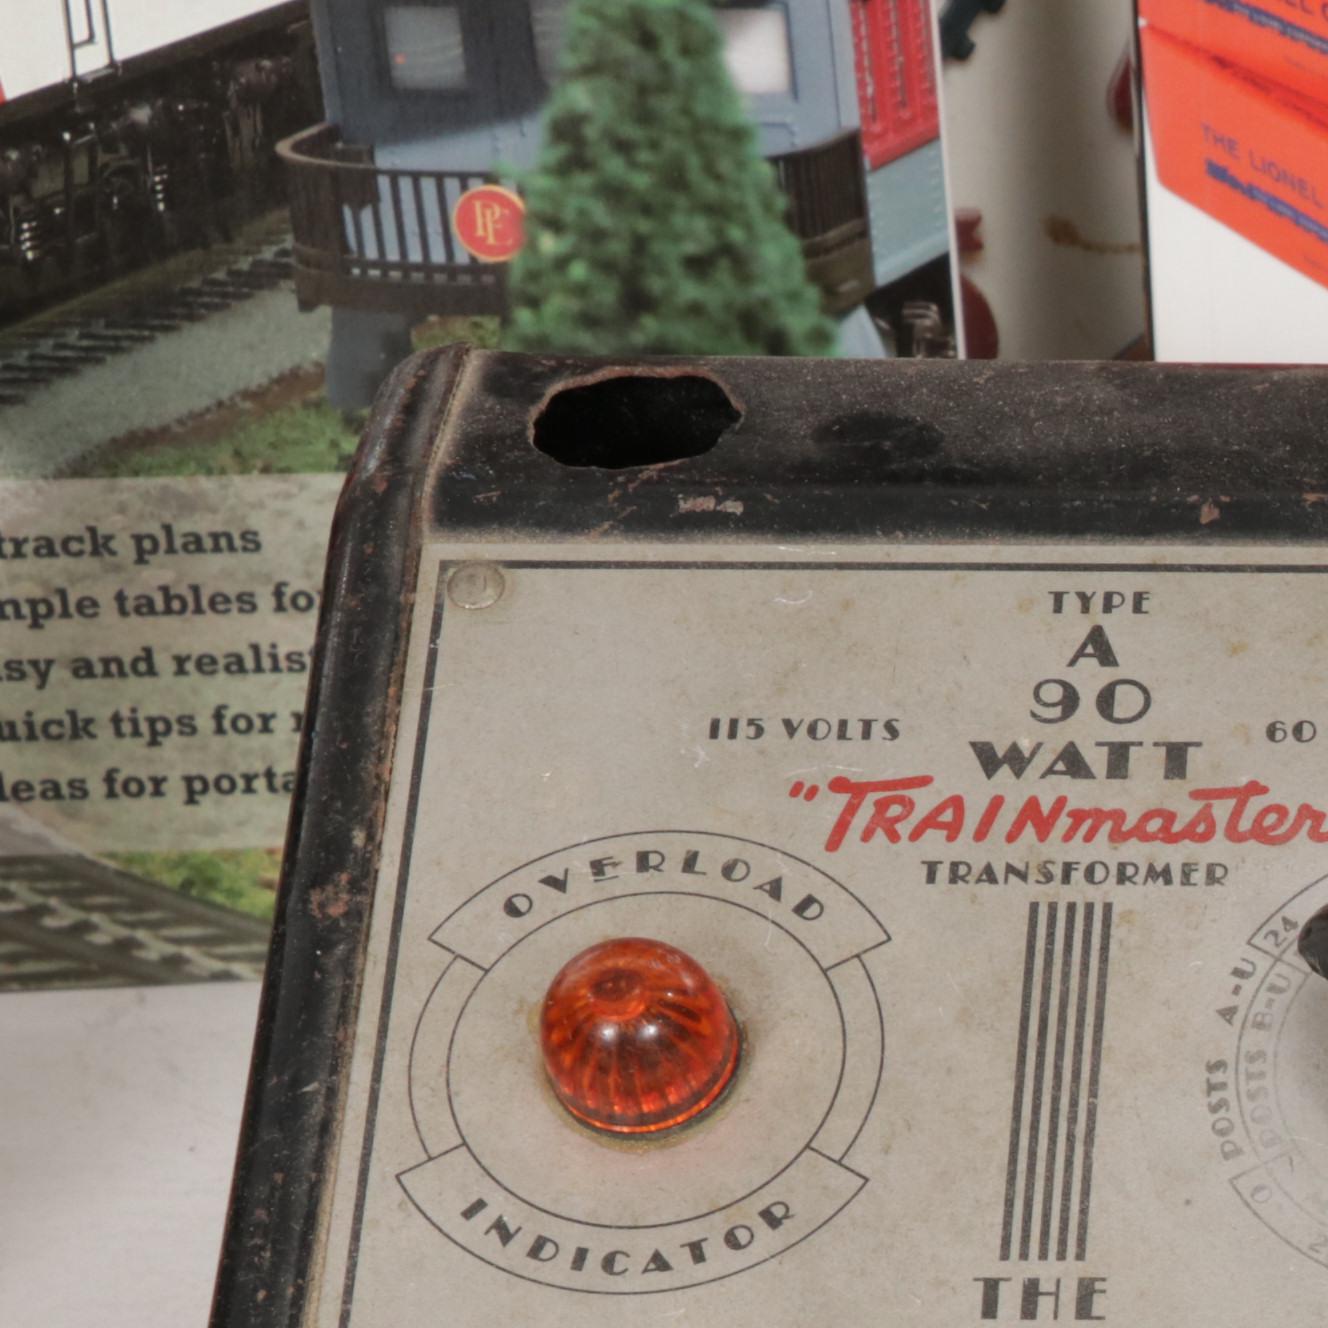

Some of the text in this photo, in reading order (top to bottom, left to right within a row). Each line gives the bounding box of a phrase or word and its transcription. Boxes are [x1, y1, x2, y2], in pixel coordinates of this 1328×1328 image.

[1200, 122, 1241, 160] THE
[1248, 150, 1326, 209] LIONEL
[131, 524, 262, 564] plans
[114, 584, 259, 617] tables
[271, 581, 323, 613] fo
[1048, 591, 1152, 614] TYPE
[0, 643, 315, 690] sy and realis
[1066, 624, 1120, 667] A
[1029, 678, 1152, 724] 90
[109, 706, 198, 747] tips
[212, 704, 277, 735] for
[708, 717, 900, 742] 115 VOLTS
[1265, 720, 1318, 744] 60
[968, 741, 1203, 780] WATT
[103, 767, 169, 800] for
[503, 849, 825, 922] OVERLOAD
[920, 860, 1230, 887] TRANSFORMER
[1263, 915, 1299, 954] 24
[1206, 957, 1258, 1162] POSTS A-U
[1244, 972, 1292, 1149] POSTS B-U
[460, 1197, 795, 1277] INDICATOR
[973, 1277, 1108, 1321] THE
